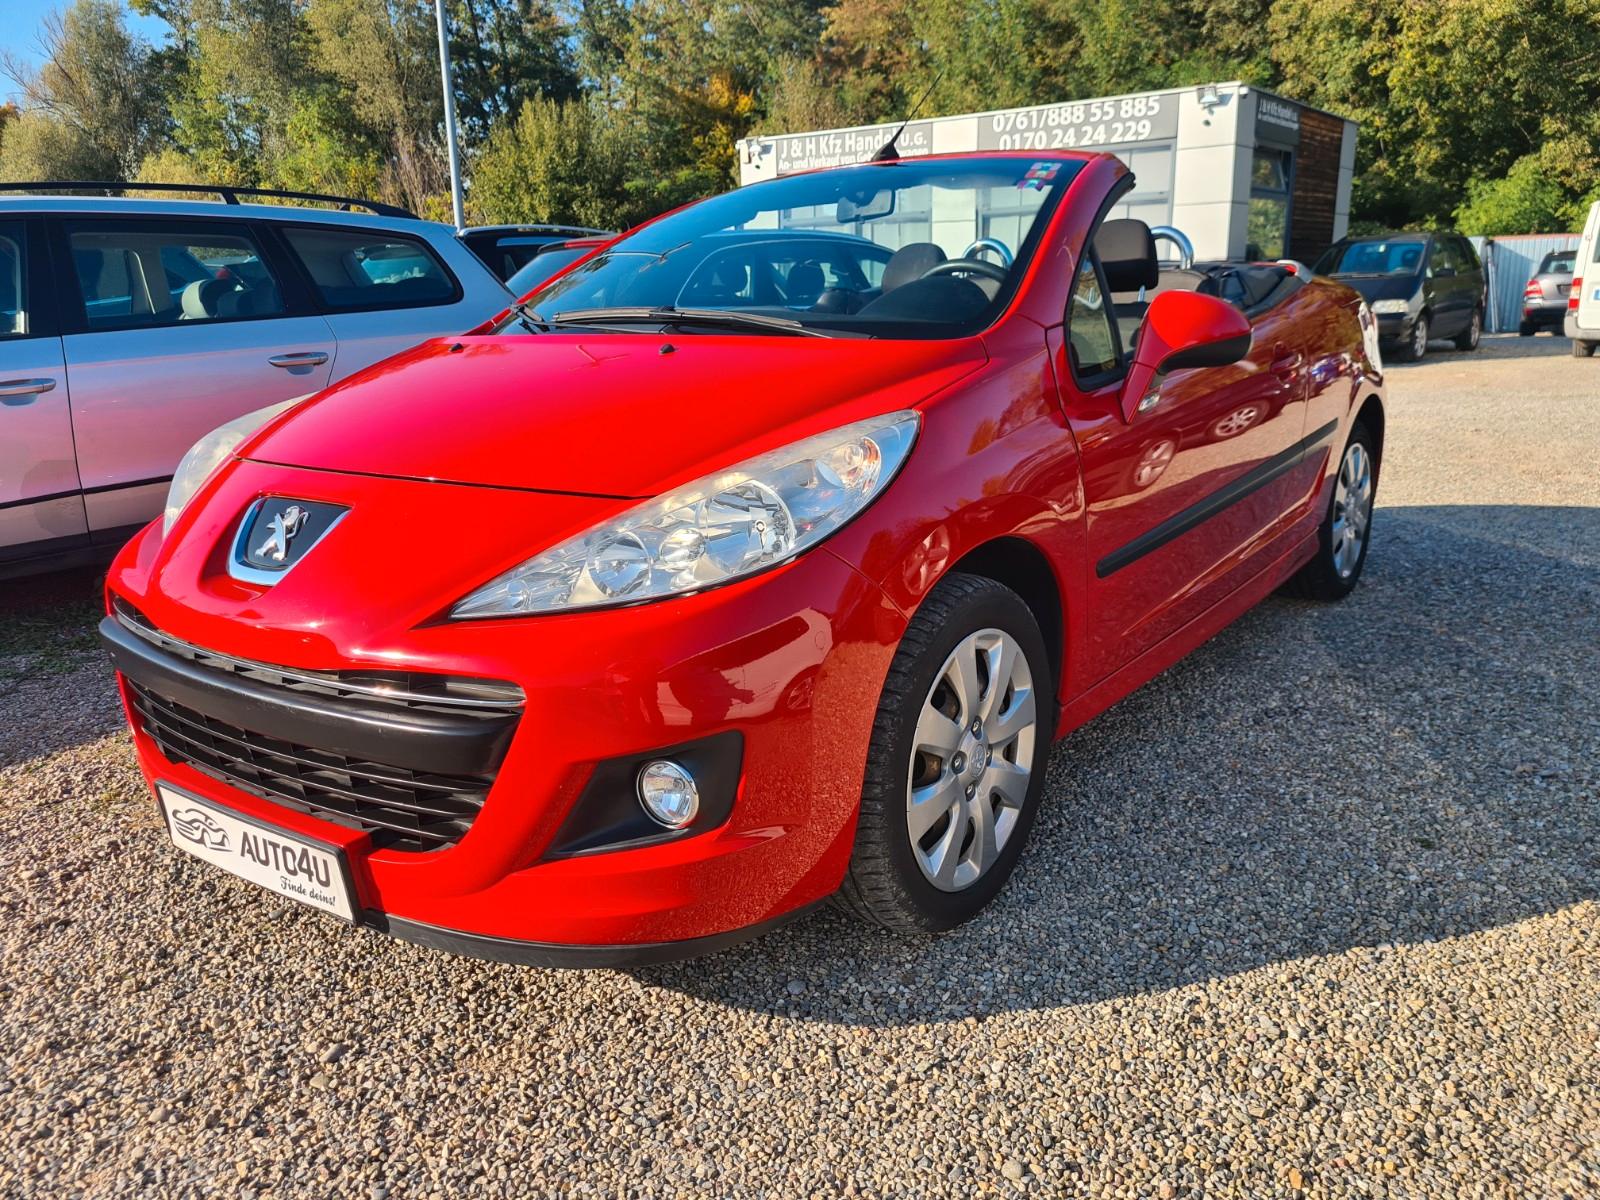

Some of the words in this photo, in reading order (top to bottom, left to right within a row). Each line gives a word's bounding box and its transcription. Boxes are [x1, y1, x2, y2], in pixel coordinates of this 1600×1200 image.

[993, 105, 1085, 132] 0761/888
[1090, 100, 1115, 123] 55
[1119, 95, 1160, 119] 885
[781, 141, 788, 159] J
[791, 139, 802, 158] &
[806, 137, 816, 156] H
[820, 133, 842, 154] Kfz
[999, 130, 1047, 150] 0170
[1050, 127, 1076, 148] 24
[1079, 124, 1106, 146] 24
[1110, 119, 1151, 143] 229
[240, 831, 331, 888] AUTO4U
[280, 875, 307, 897] Finde
[309, 887, 336, 907] deins!
